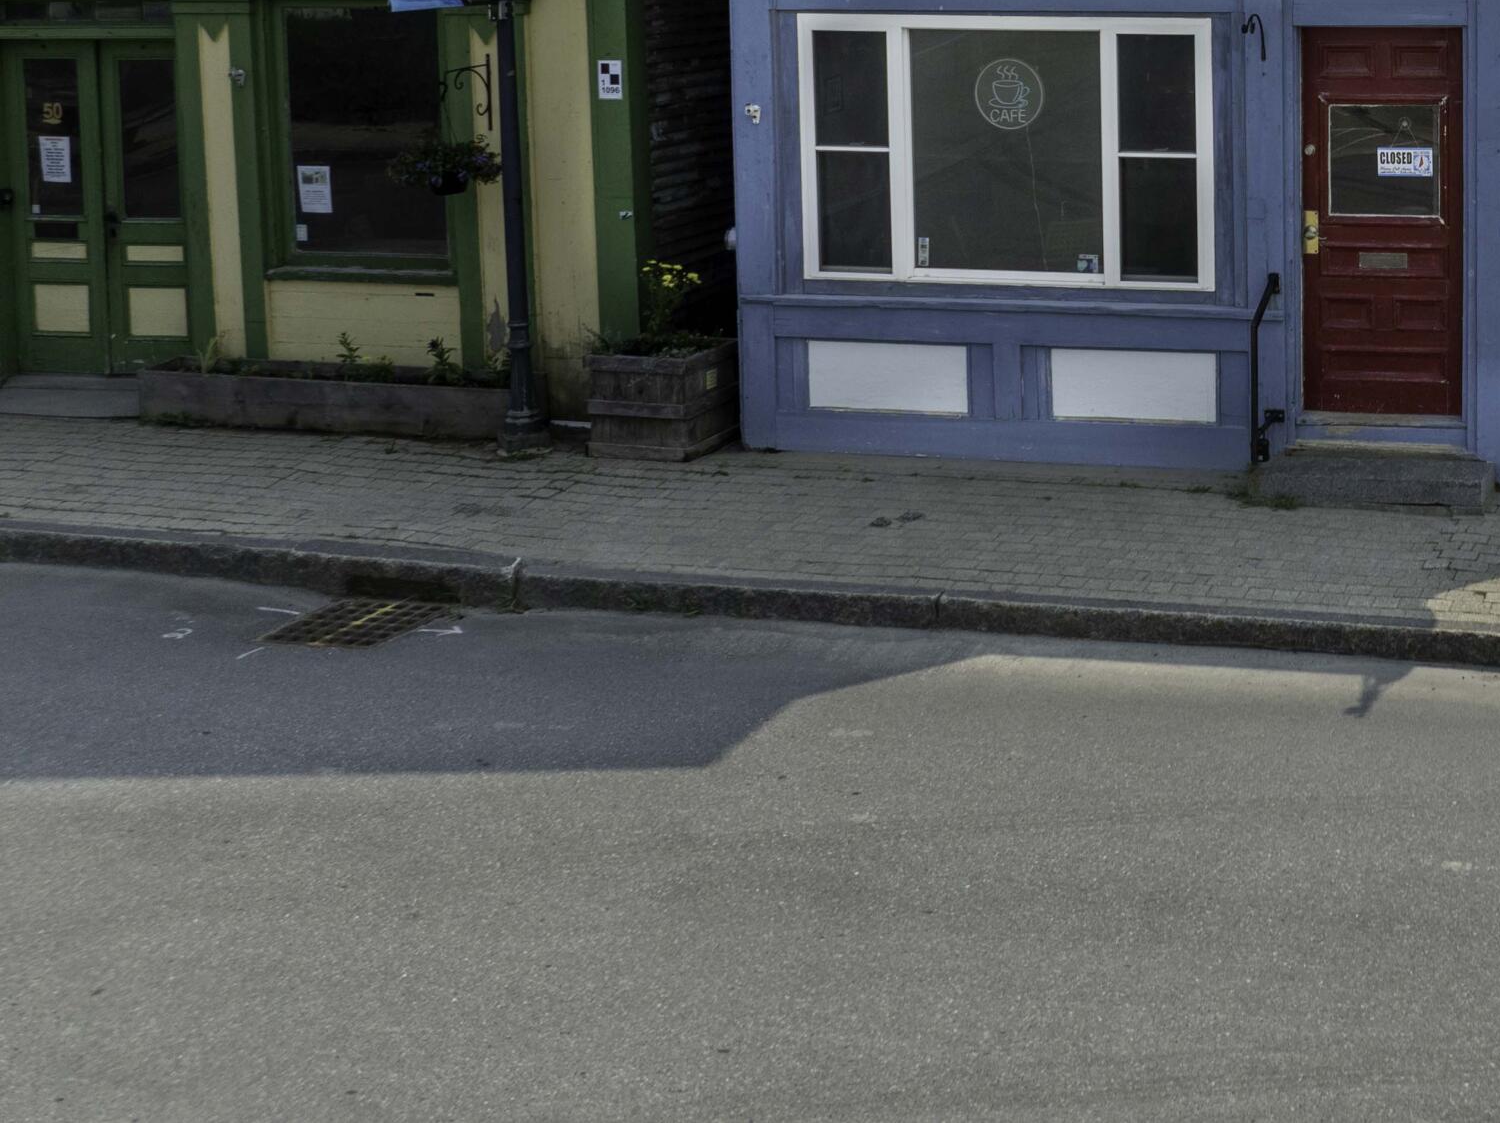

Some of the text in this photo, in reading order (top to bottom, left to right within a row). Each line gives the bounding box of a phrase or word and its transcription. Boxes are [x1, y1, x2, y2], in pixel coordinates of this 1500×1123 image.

[42, 102, 64, 119] 50
[990, 109, 1027, 123] CAFE
[1380, 152, 1412, 165] CLOSED
